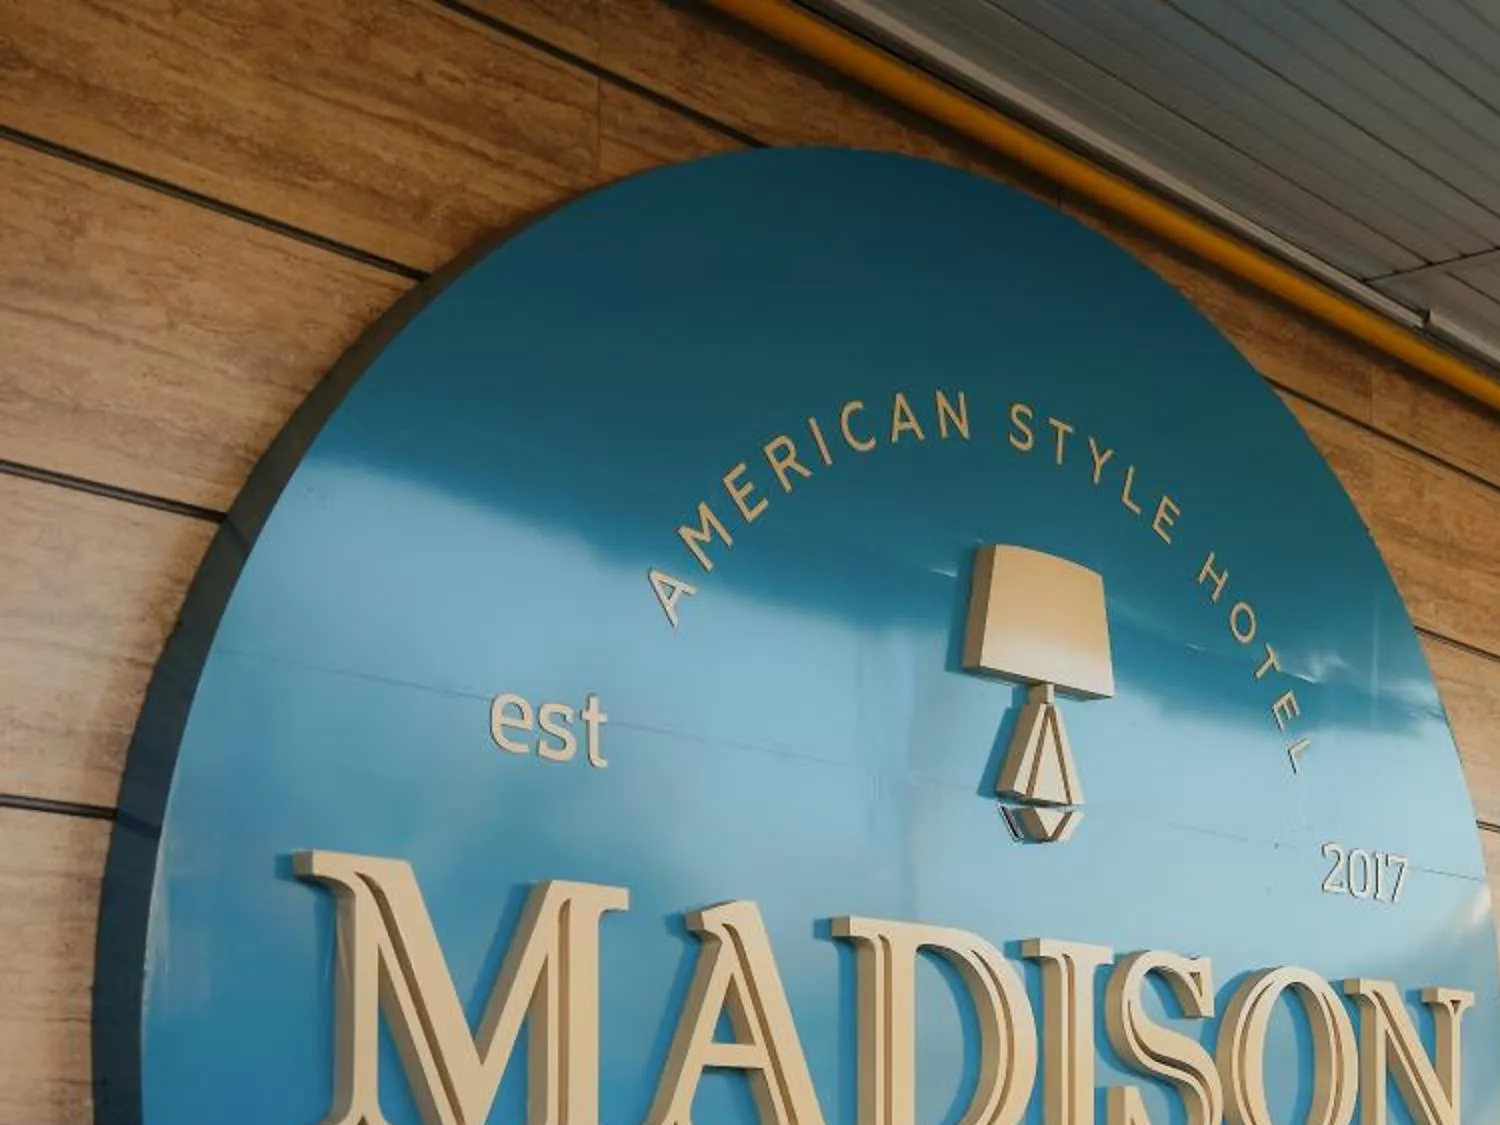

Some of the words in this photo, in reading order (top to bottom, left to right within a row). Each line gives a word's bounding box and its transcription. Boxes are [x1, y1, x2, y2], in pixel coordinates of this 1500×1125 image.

[648, 390, 971, 628] AMERICAN
[1008, 403, 1182, 543] STYLE
[1199, 551, 1311, 774] HOTEL
[490, 692, 608, 768] est
[1321, 842, 1407, 903] 2017
